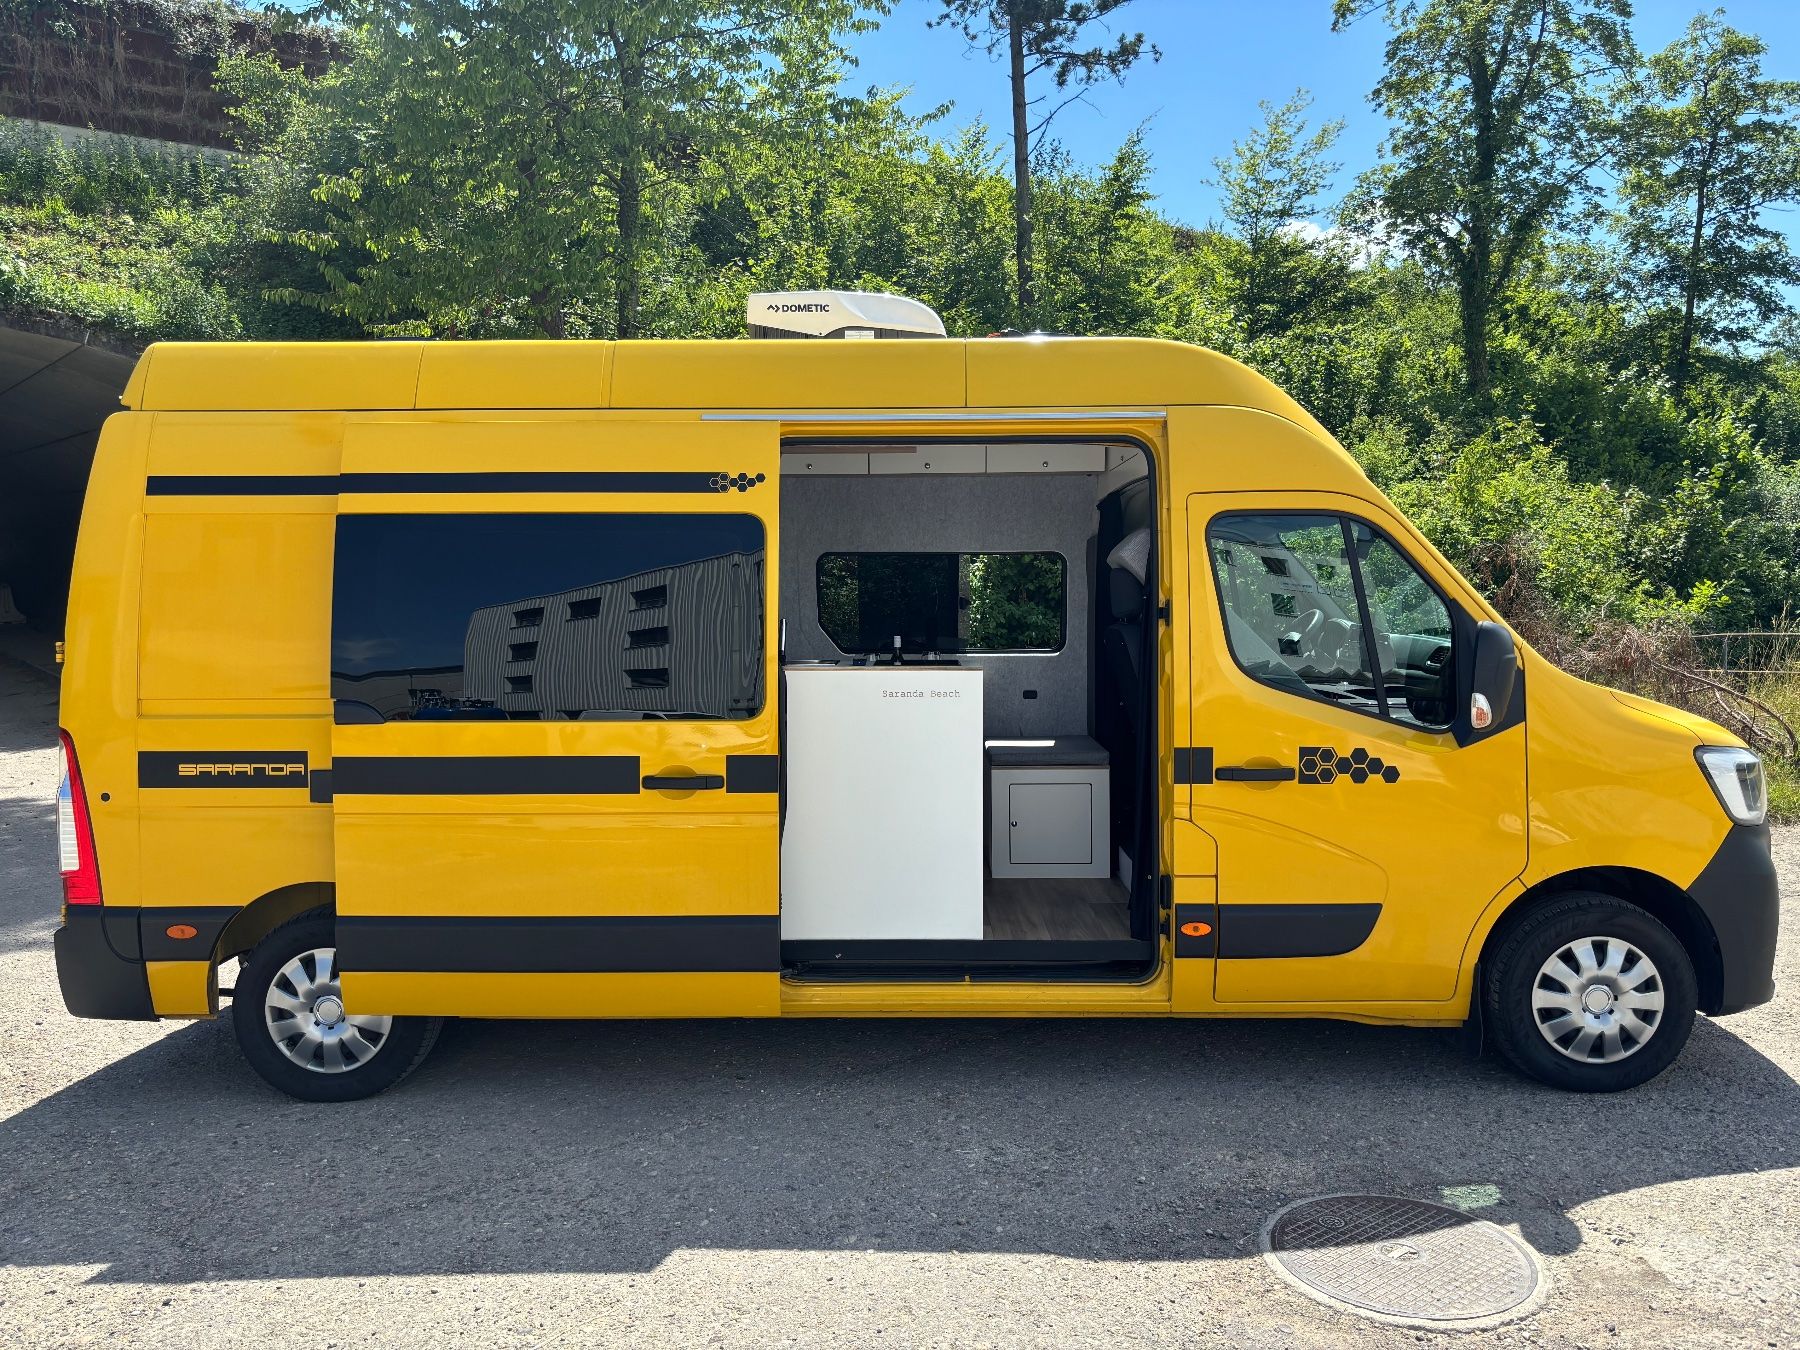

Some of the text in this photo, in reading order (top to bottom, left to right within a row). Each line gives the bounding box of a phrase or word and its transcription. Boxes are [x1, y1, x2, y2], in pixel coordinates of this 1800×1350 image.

[781, 303, 830, 313] DOMETIC
[882, 689, 961, 698] Saranda Beach
[178, 763, 305, 776] SARANDA
